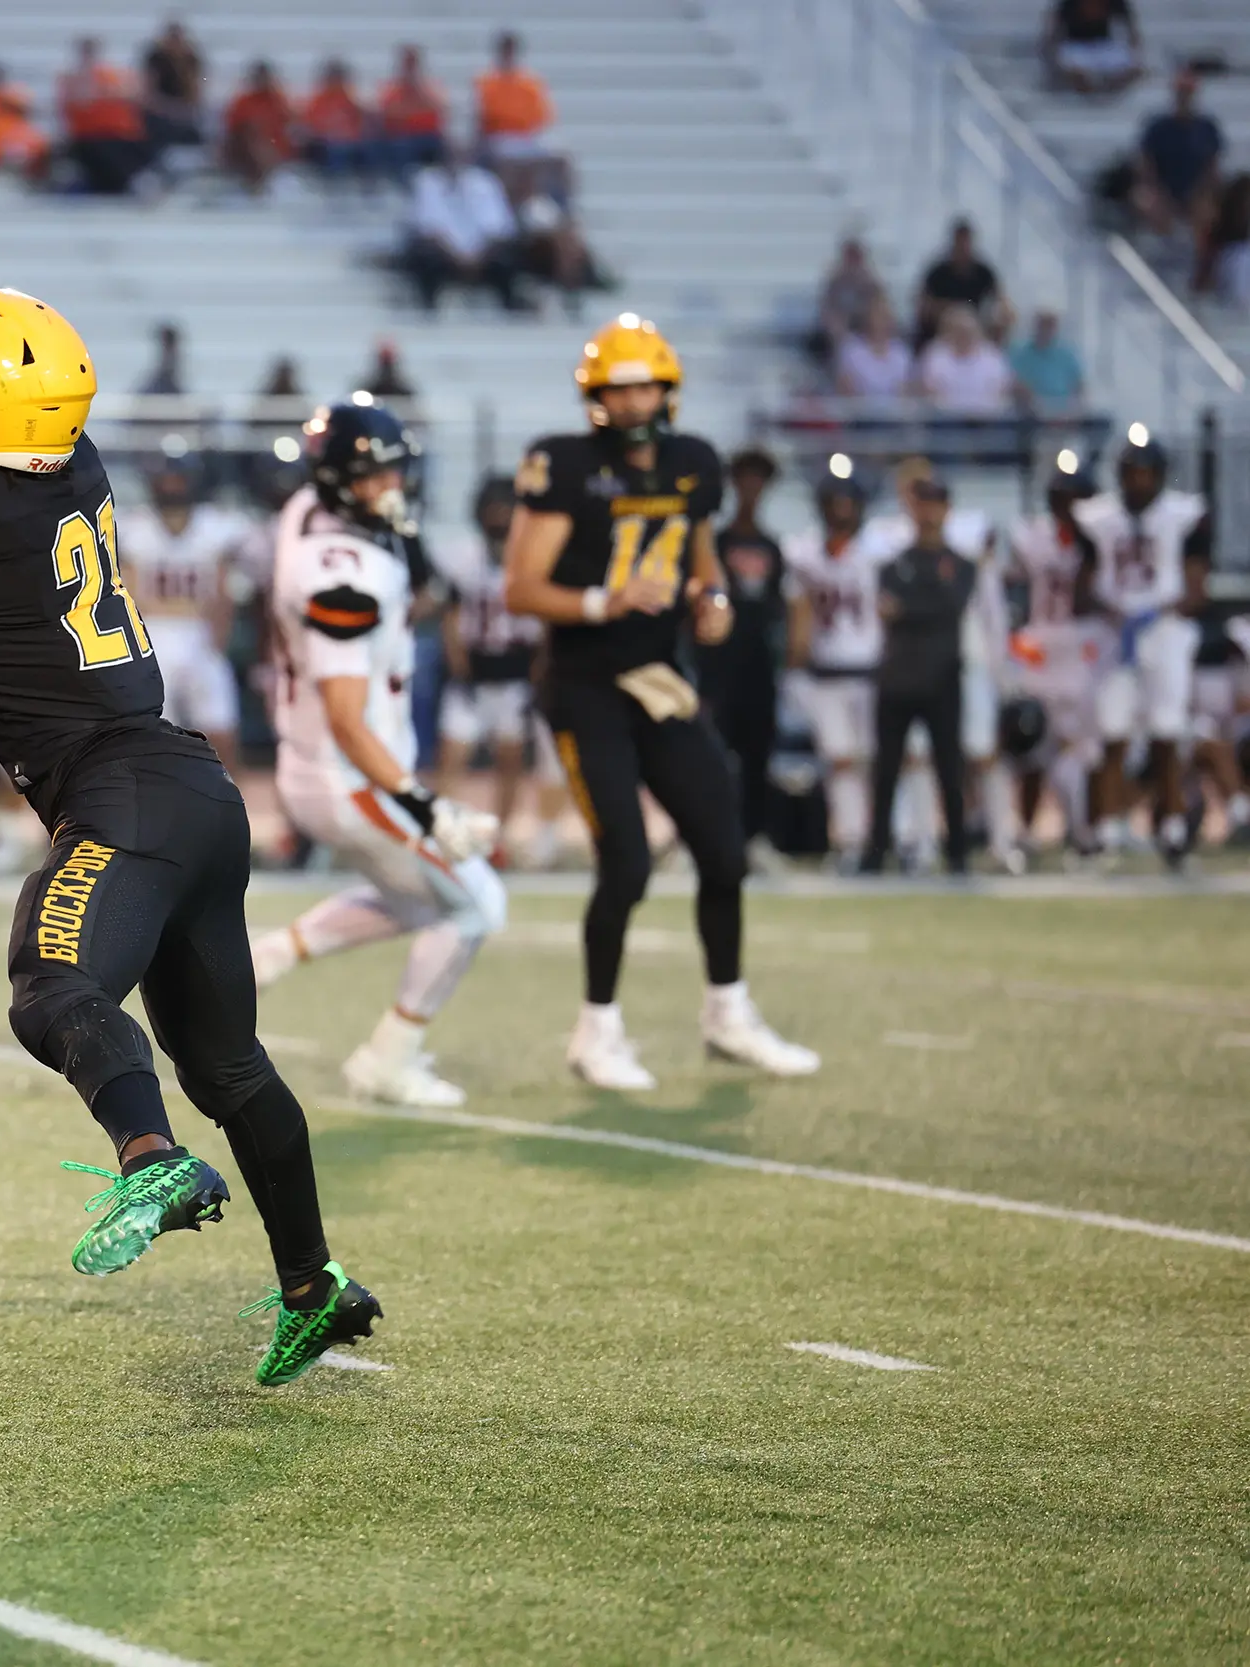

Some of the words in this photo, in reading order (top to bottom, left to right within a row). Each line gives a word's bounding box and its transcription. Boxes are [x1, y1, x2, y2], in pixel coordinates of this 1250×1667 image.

[27, 457, 67, 472] Ridd
[52, 494, 154, 671] 21
[604, 513, 688, 608] 14
